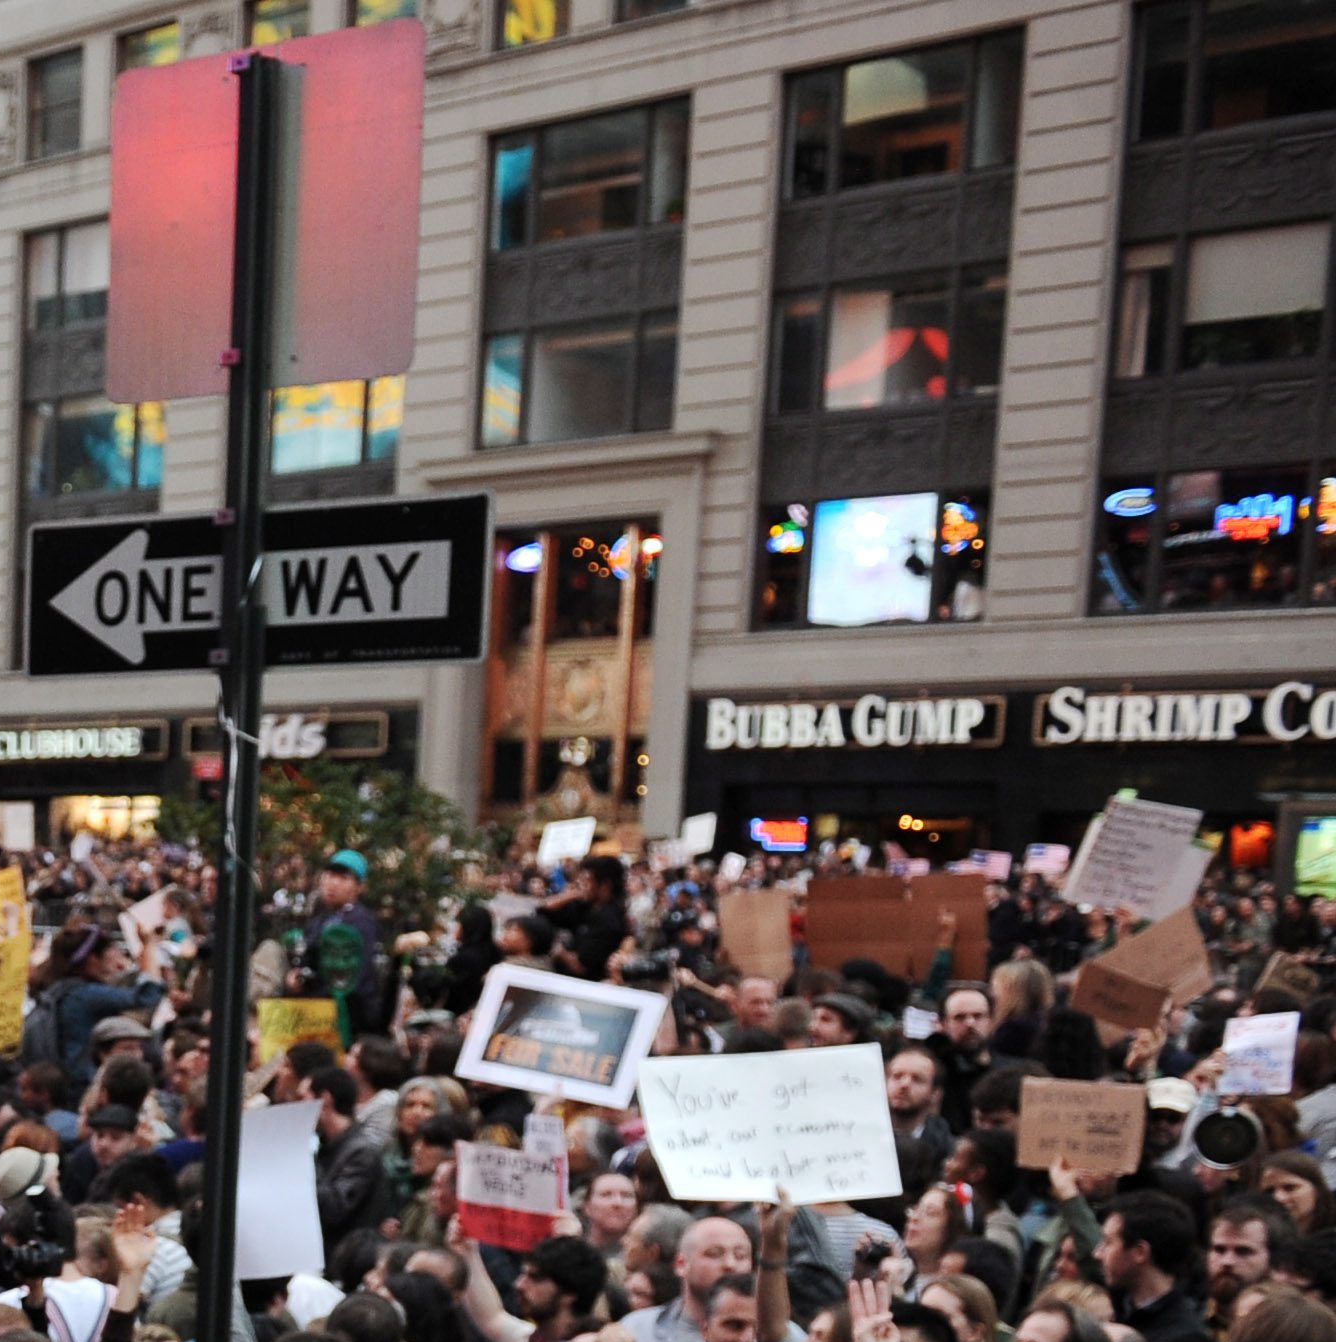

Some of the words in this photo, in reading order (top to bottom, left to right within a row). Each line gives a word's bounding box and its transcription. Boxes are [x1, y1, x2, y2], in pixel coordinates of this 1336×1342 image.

[95, 562, 214, 628] ONE
[280, 551, 420, 617] WAY
[258, 713, 327, 759] ids
[706, 699, 845, 750] BUBBA
[852, 695, 985, 746] GUMP
[1046, 687, 1251, 745] SHRIMP
[484, 1031, 542, 1066] FOR
[547, 1045, 618, 1085] SALE
